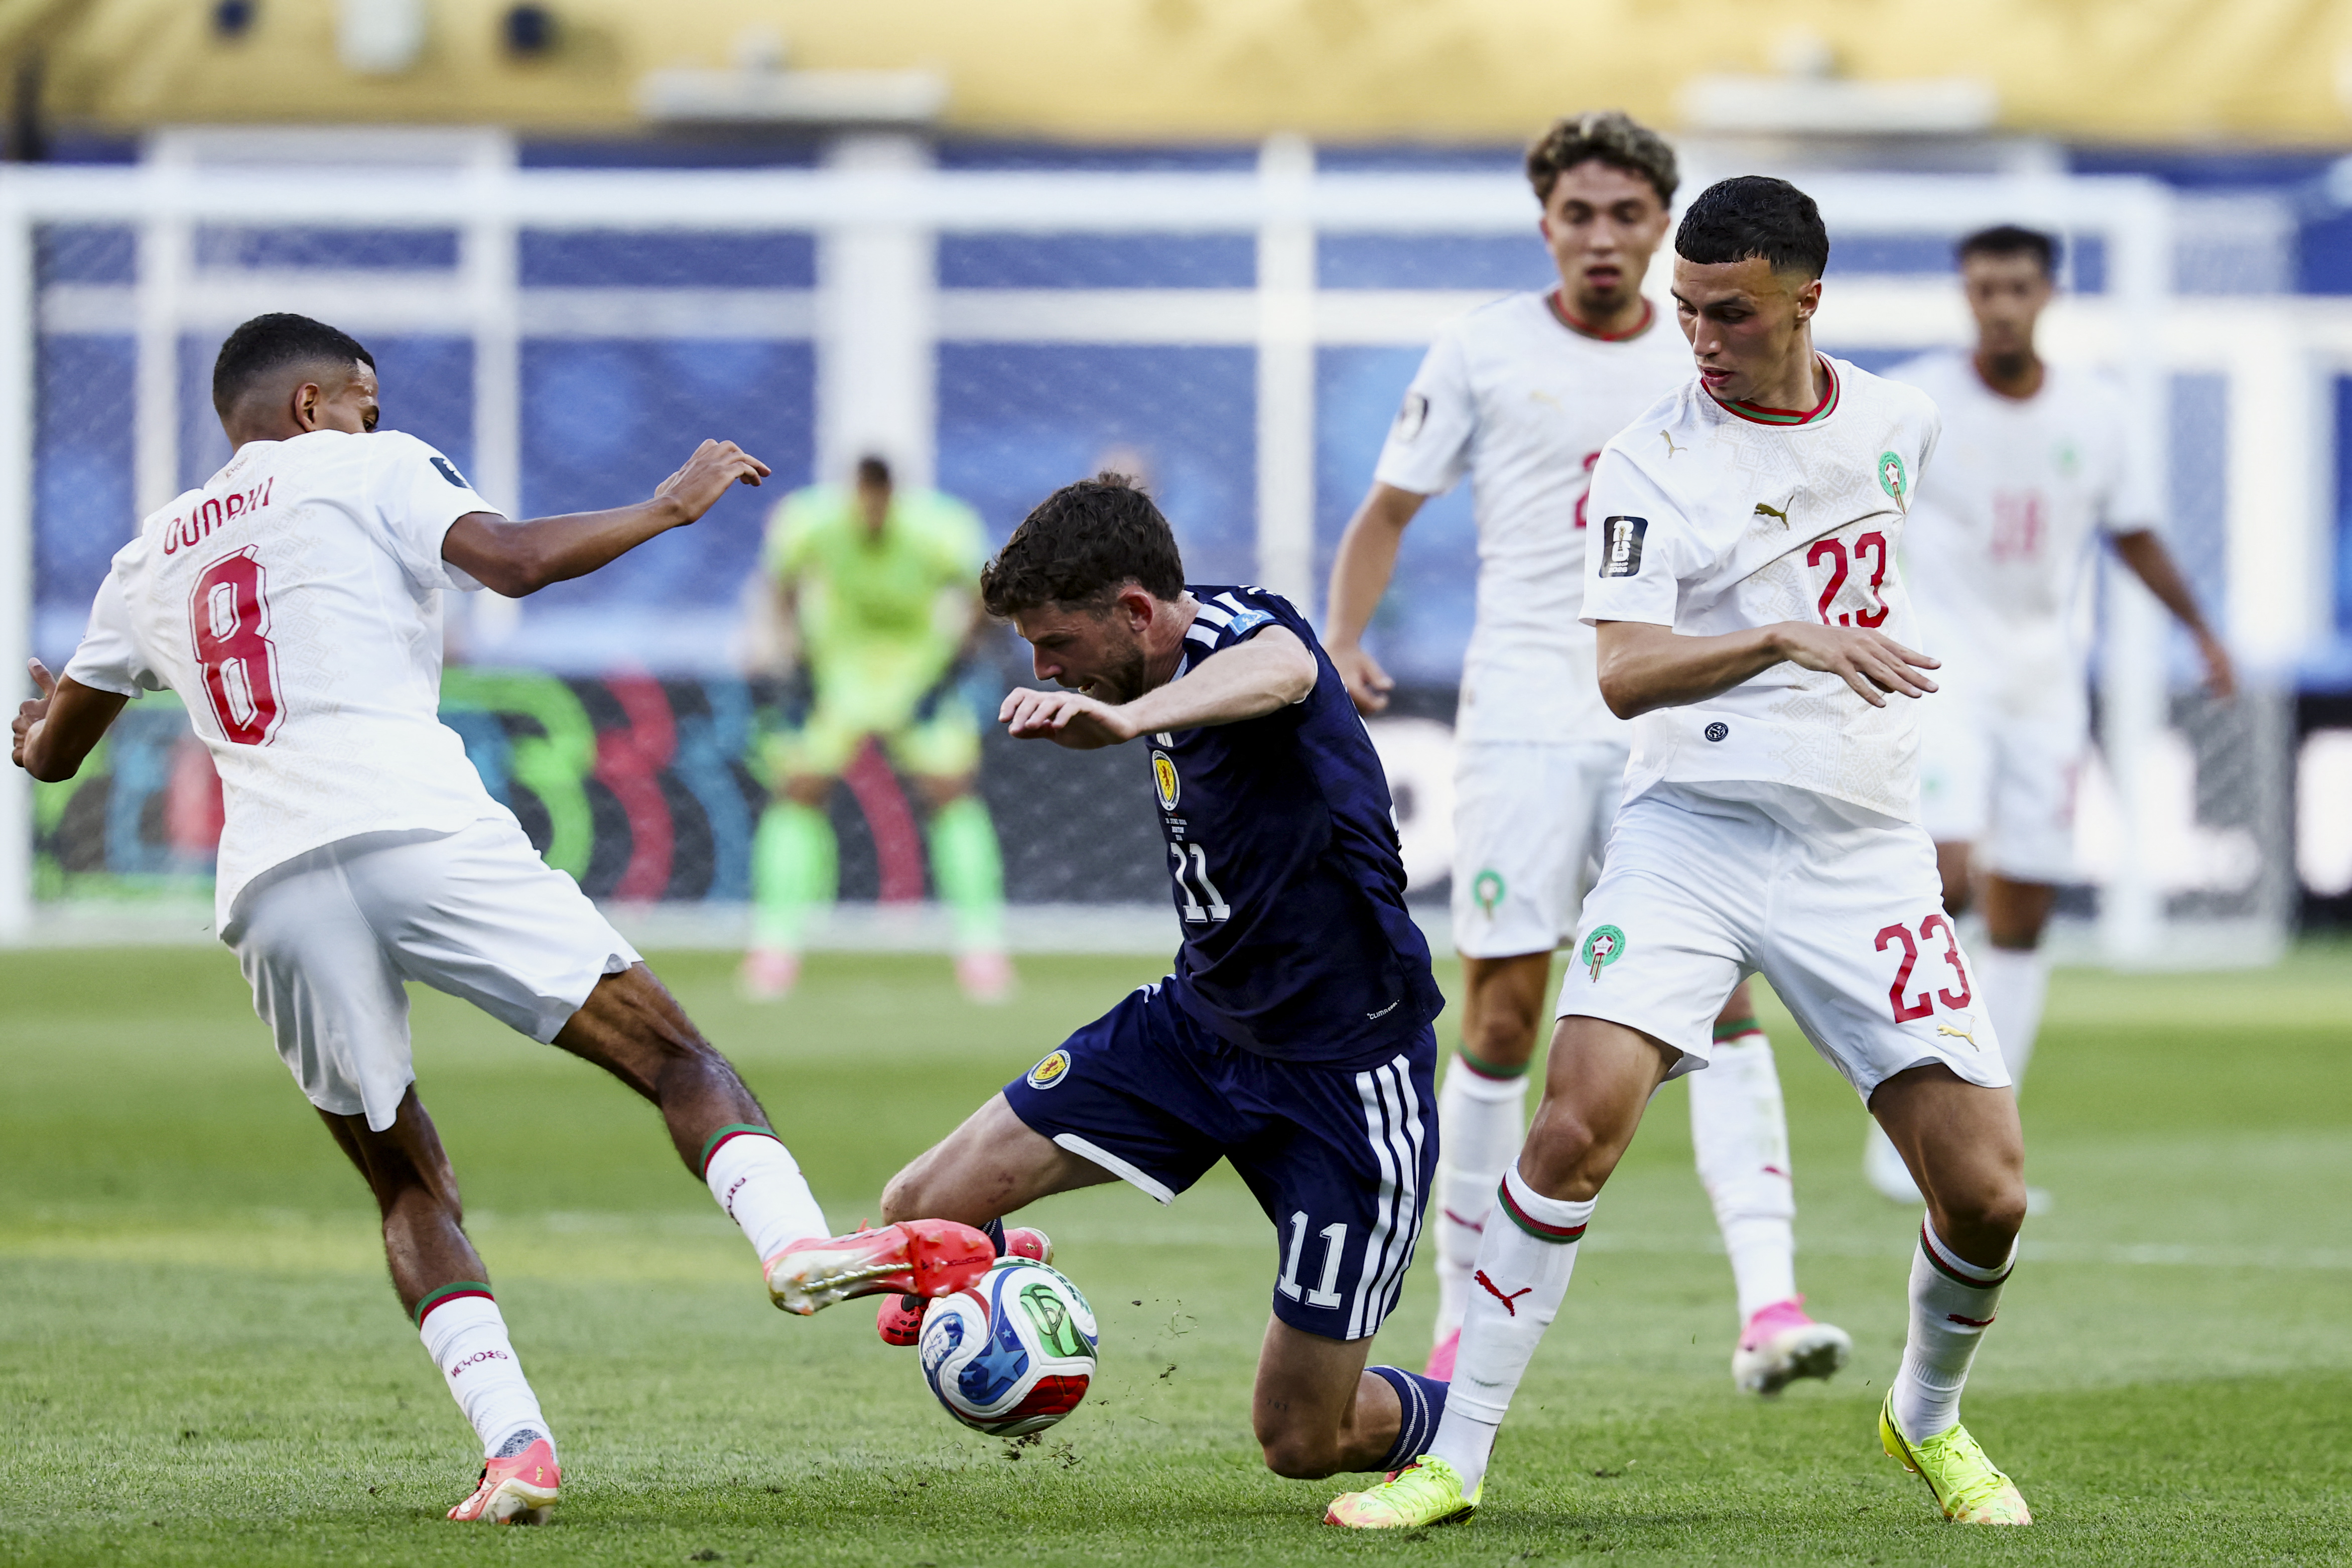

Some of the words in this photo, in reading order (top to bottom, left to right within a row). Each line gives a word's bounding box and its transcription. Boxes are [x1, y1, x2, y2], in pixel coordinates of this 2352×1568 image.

[1807, 531, 1889, 628] 23
[189, 544, 287, 747] 8
[1170, 842, 1231, 923] 11
[1874, 913, 1972, 1024] 23
[1277, 1210, 1348, 1310] 11
